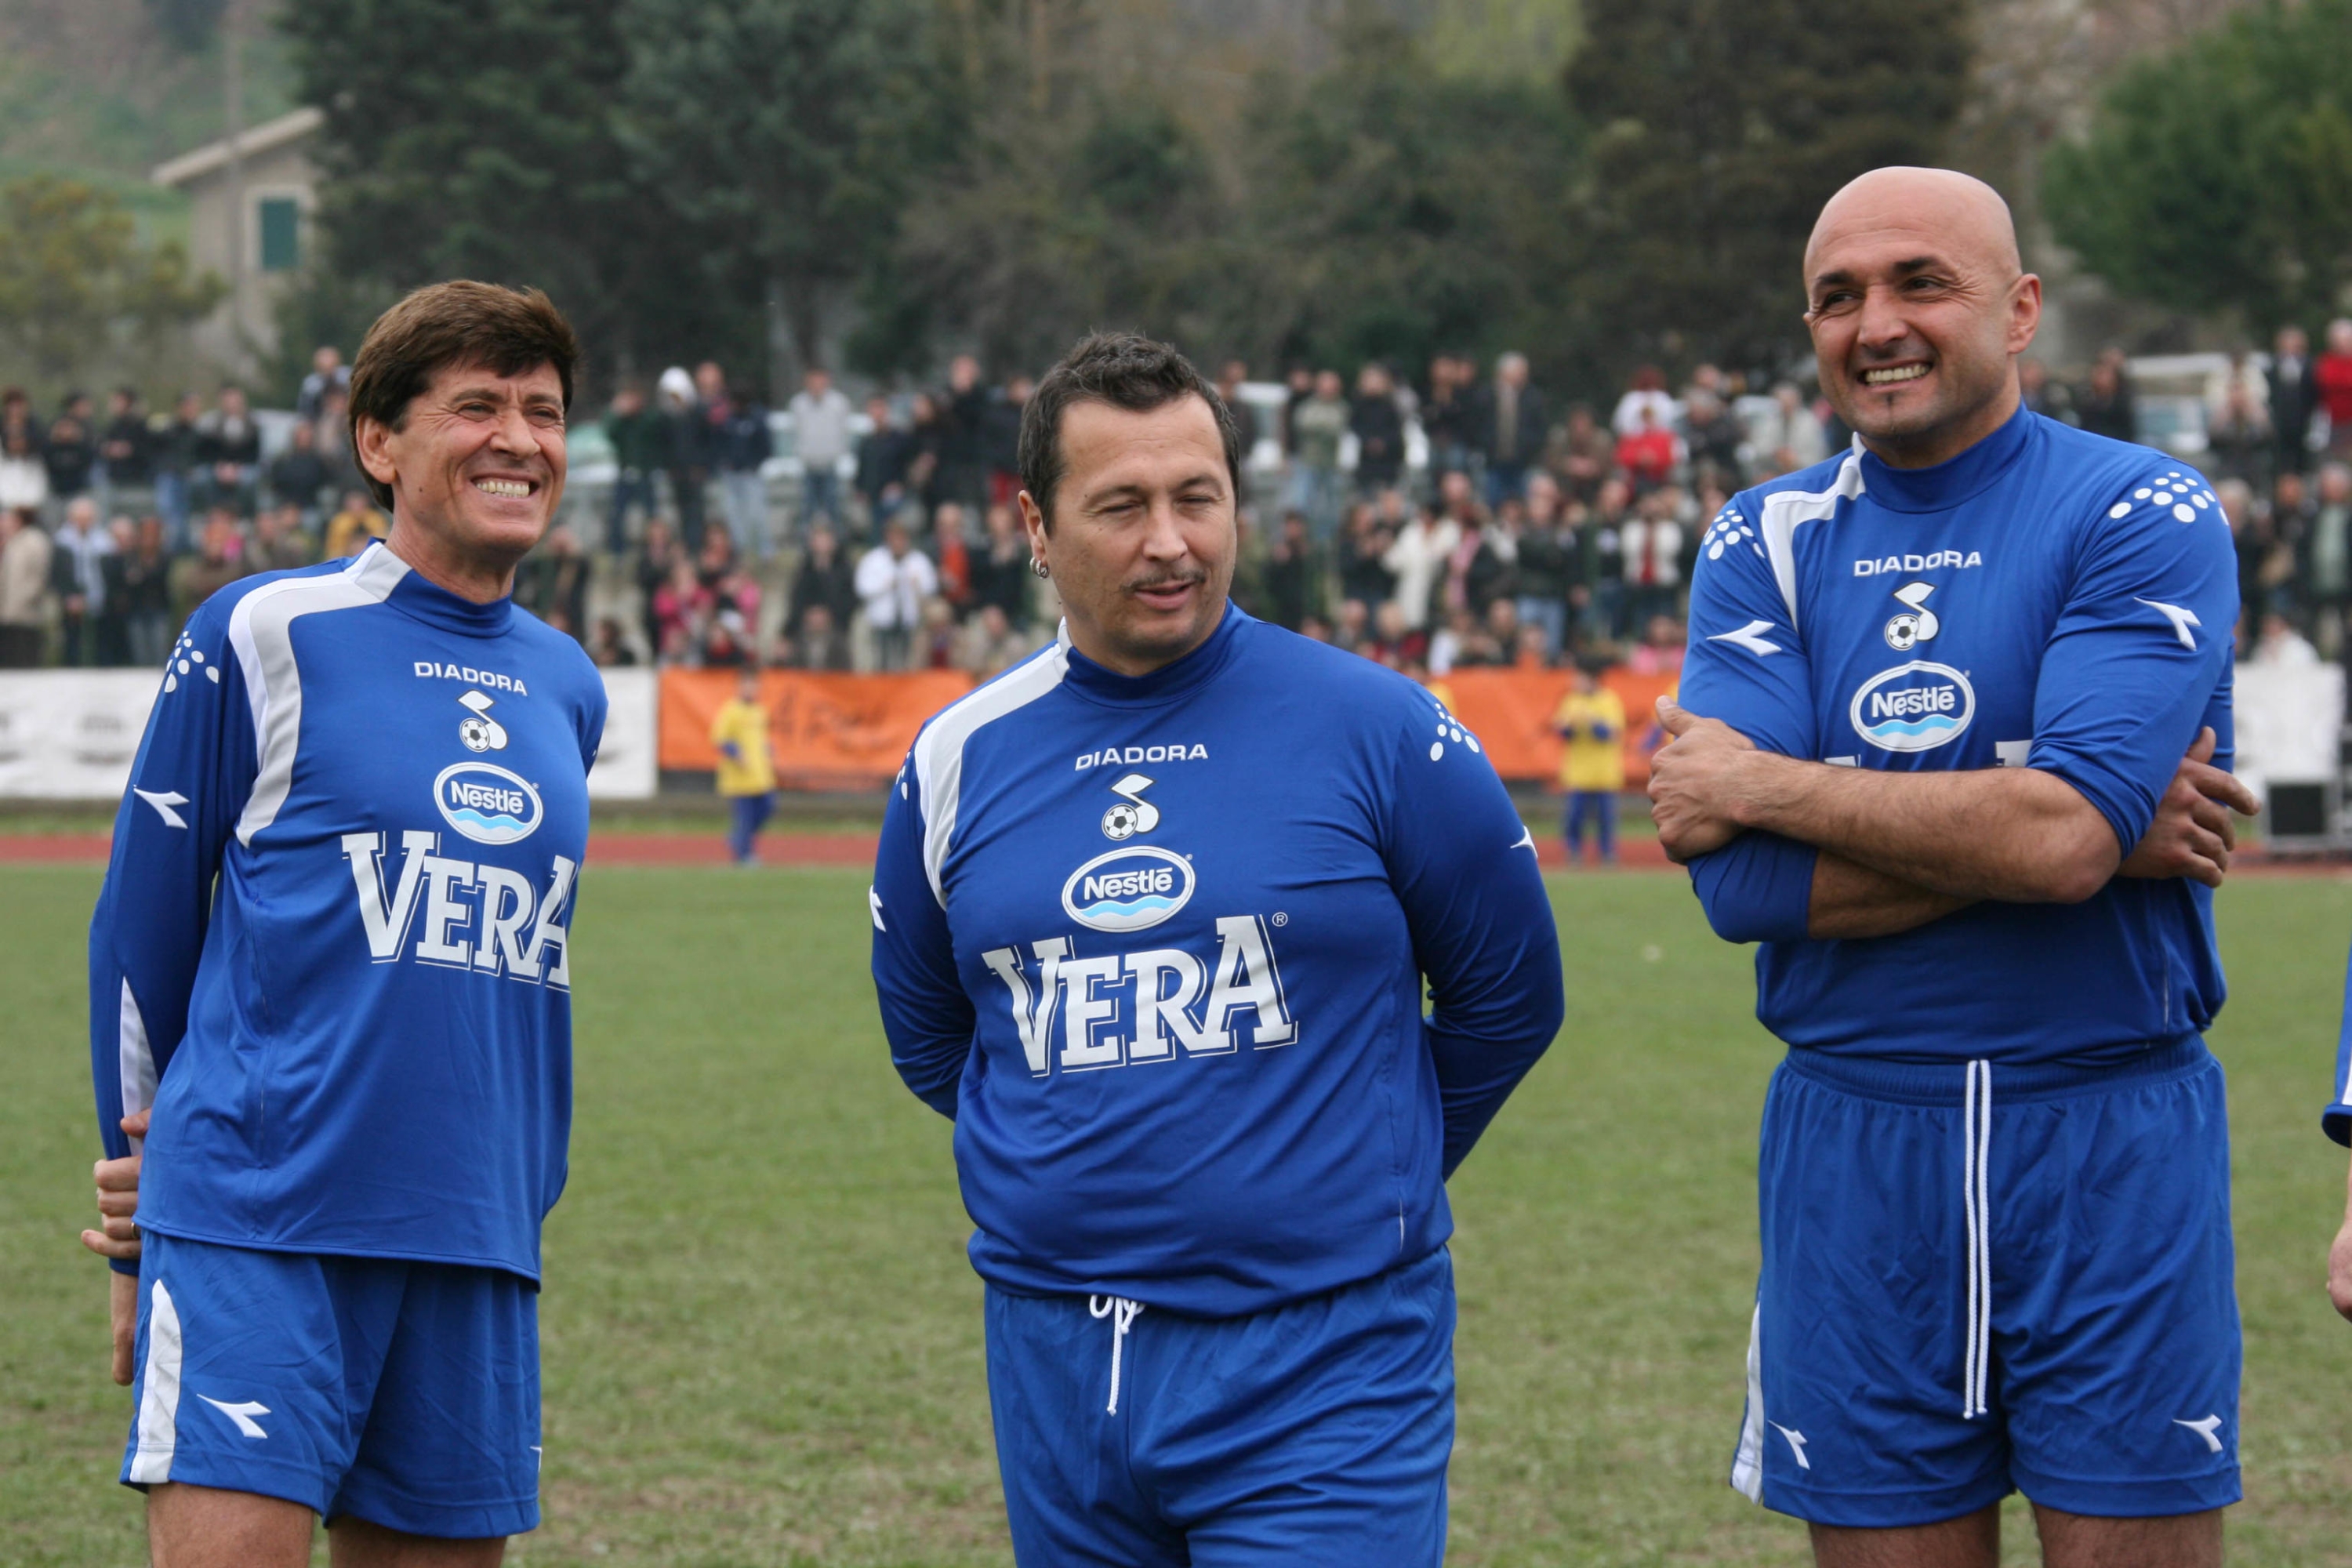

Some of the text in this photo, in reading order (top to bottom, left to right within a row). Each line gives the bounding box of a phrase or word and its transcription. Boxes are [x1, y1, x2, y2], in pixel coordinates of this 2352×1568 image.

[1853, 550, 1983, 577] DIADORA
[414, 662, 528, 696] DIADORA
[1075, 744, 1209, 771] DIADORA
[341, 829, 578, 993] VERA
